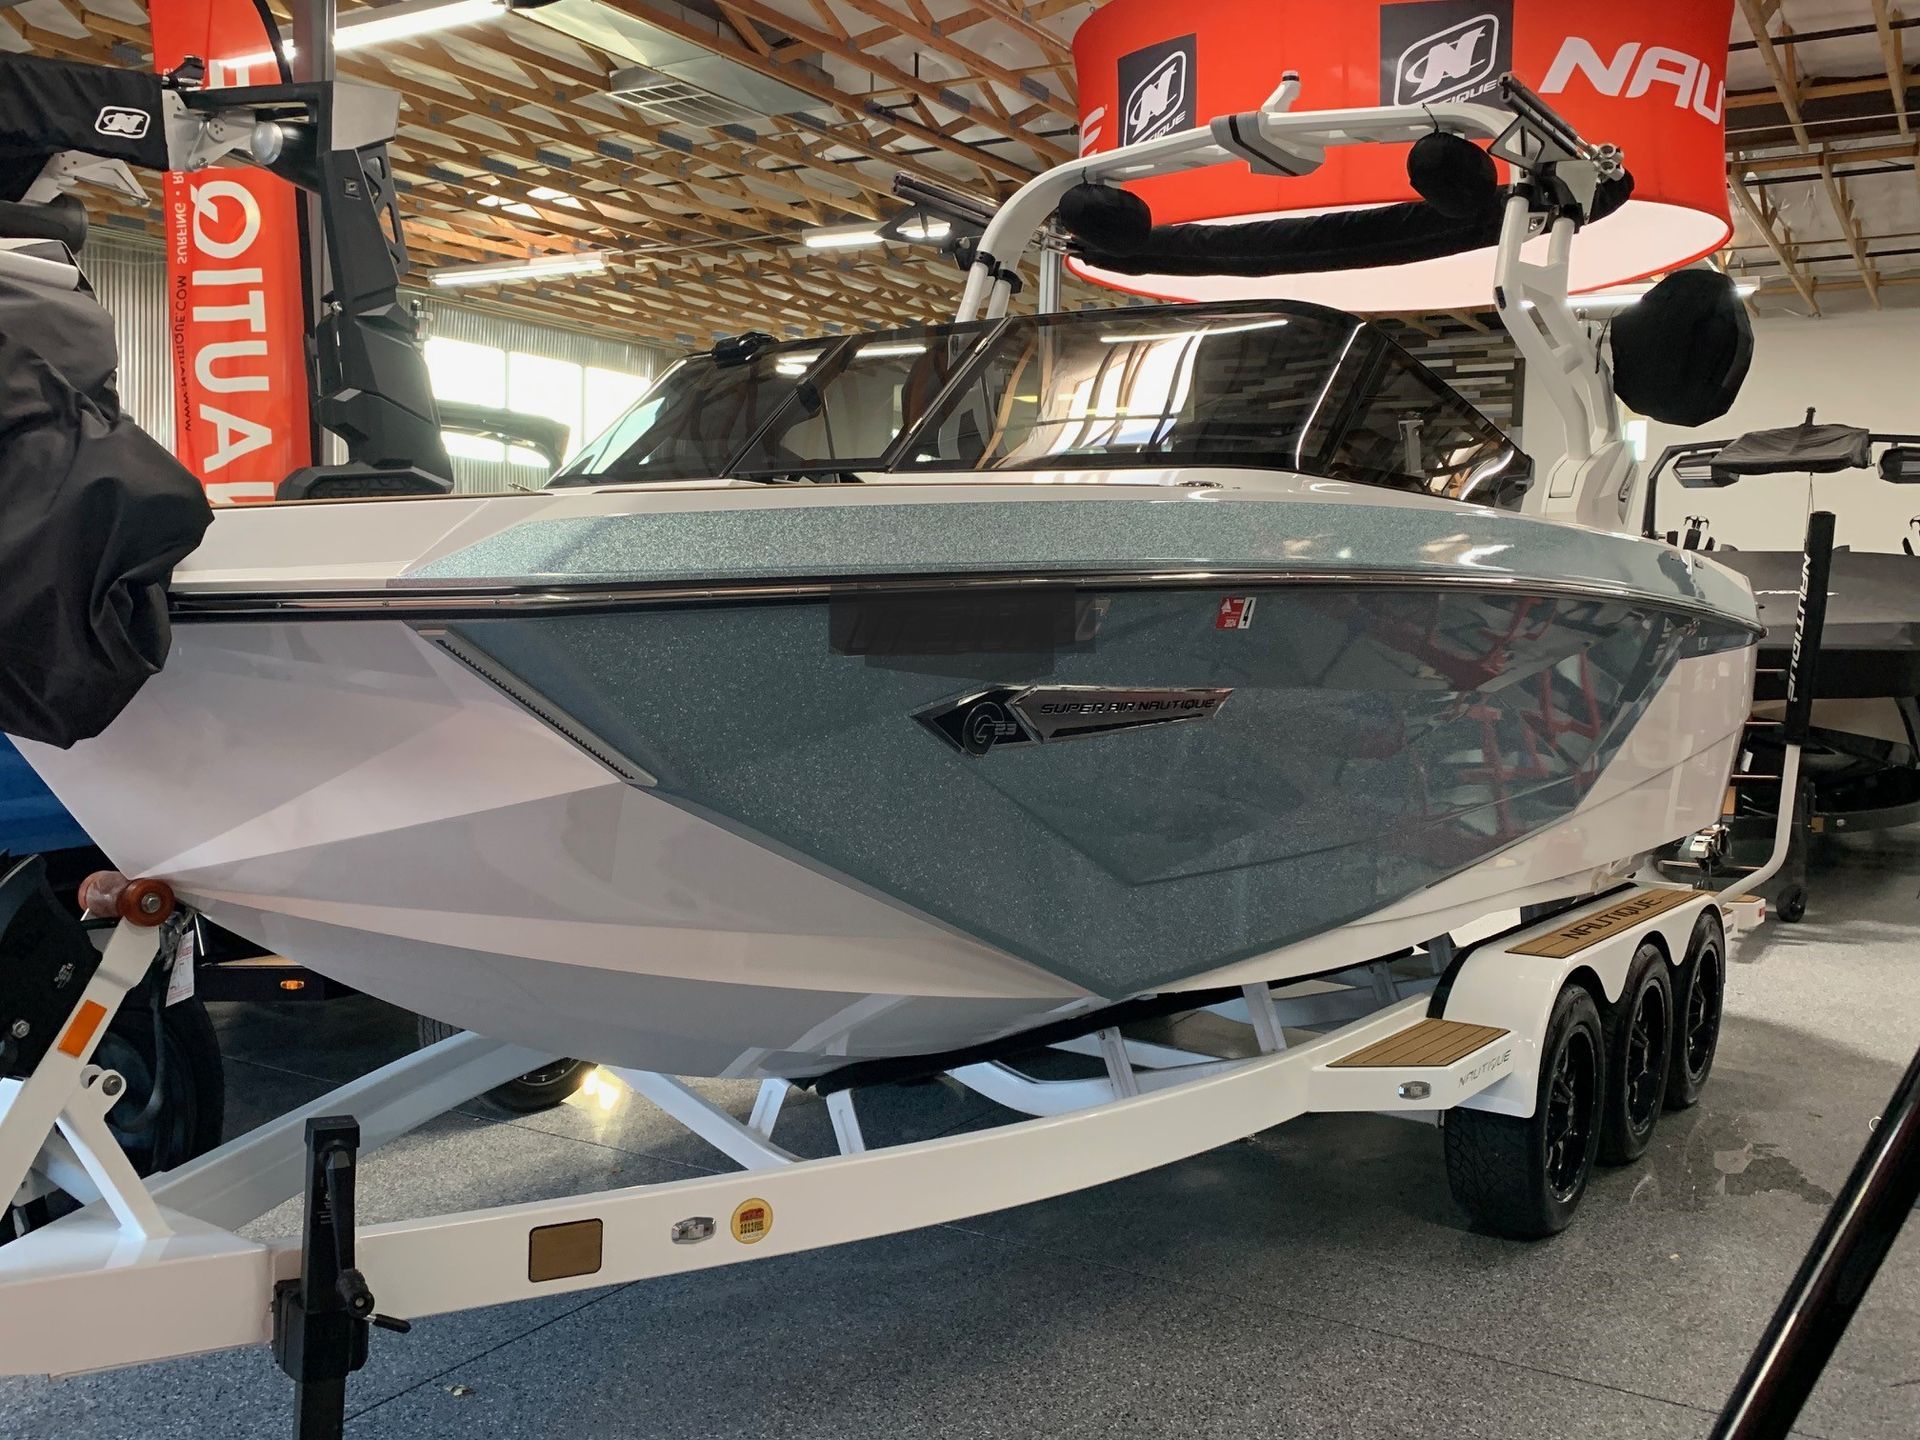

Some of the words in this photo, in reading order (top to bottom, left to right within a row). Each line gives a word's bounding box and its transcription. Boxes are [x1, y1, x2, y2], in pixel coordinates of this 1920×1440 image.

[1786, 552, 1812, 703] NAUTIQUE
[1041, 702, 1105, 715] SUPER
[1106, 702, 1136, 713] AIR
[1137, 698, 1216, 712] NAUTIQUE
[1559, 897, 1664, 940] NAUTIQUE
[1458, 1048, 1512, 1088] NAUTIQUE
